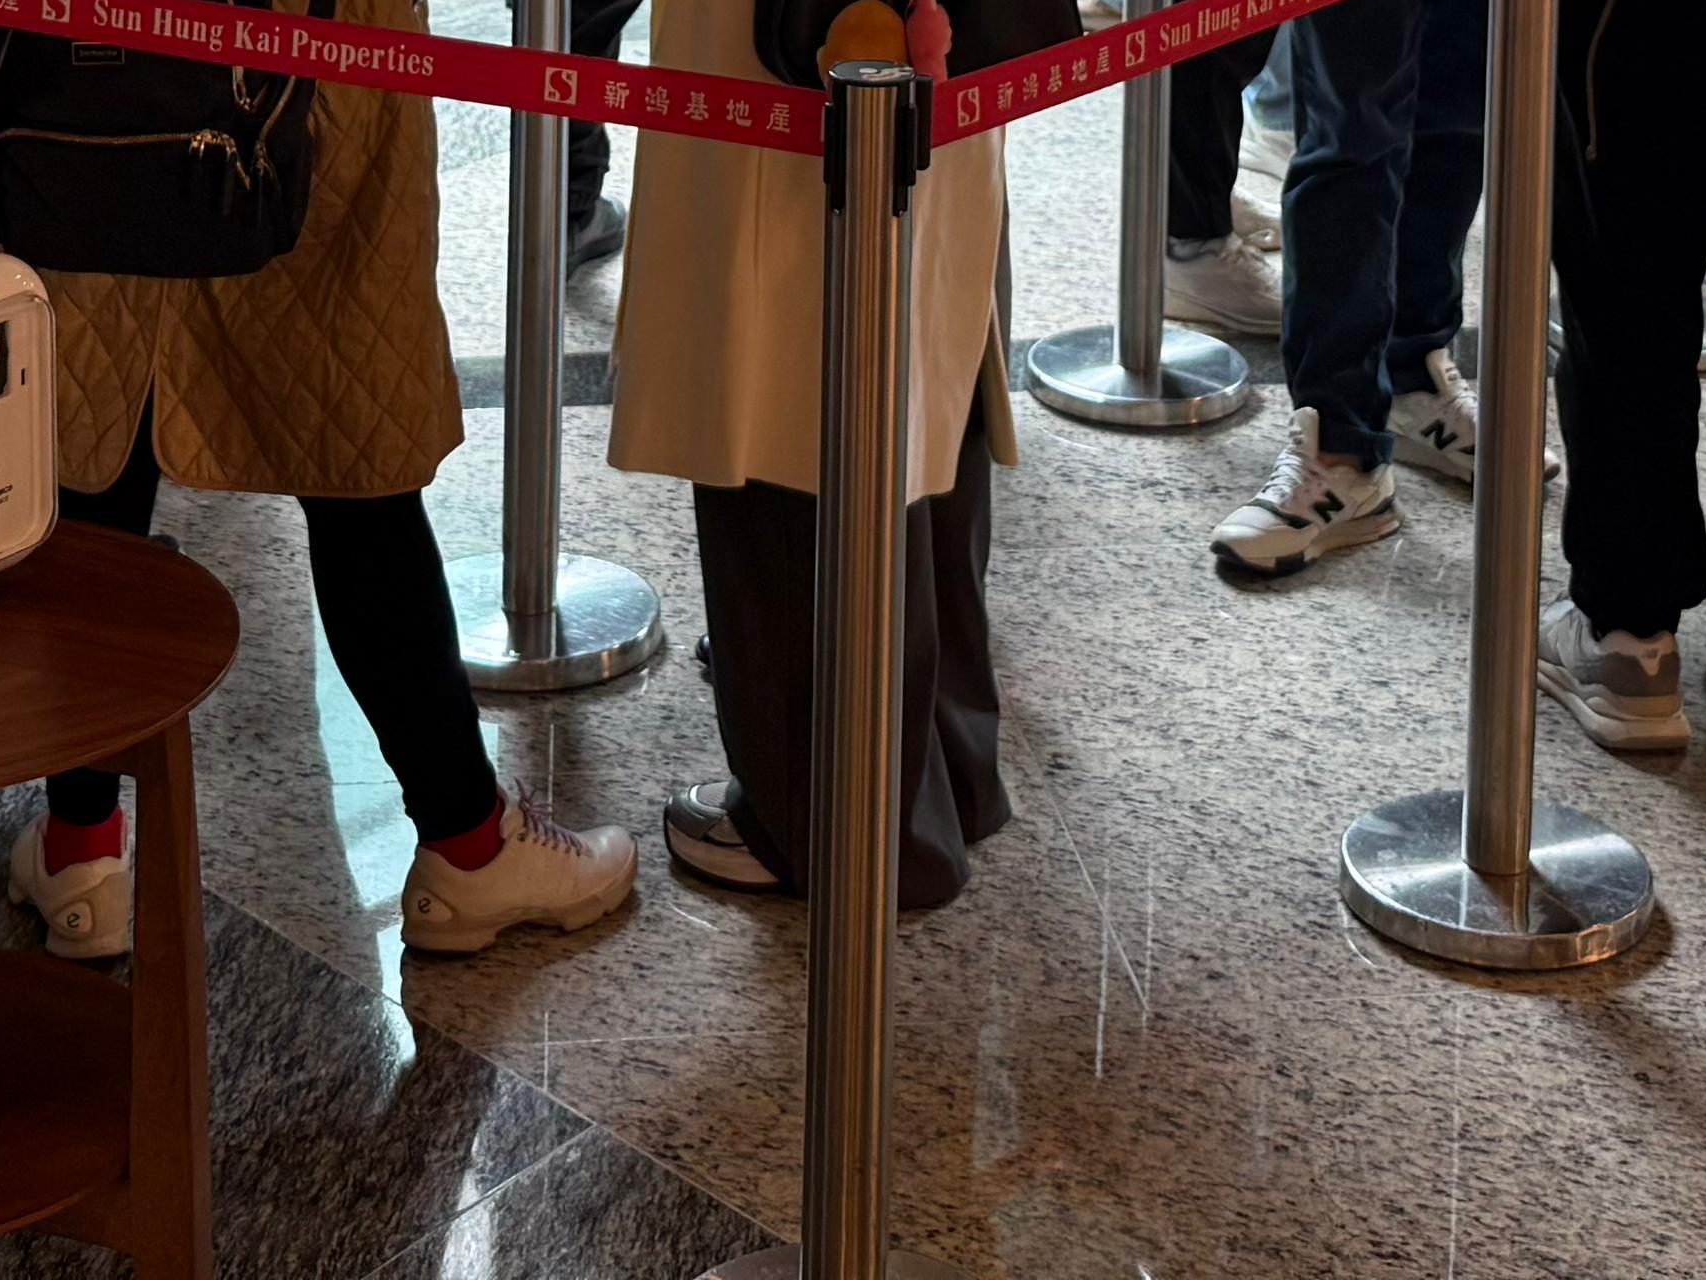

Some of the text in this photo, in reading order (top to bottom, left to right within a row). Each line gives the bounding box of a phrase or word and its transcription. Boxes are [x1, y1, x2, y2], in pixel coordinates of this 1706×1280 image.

[152, 7, 224, 52] Hung
[233, 19, 280, 56] Kai
[291, 28, 435, 77] Properties
[1159, 20, 1191, 52] Sun
[1197, 0, 1242, 37] Hung
[603, 80, 792, 133] 新鴻基地產
